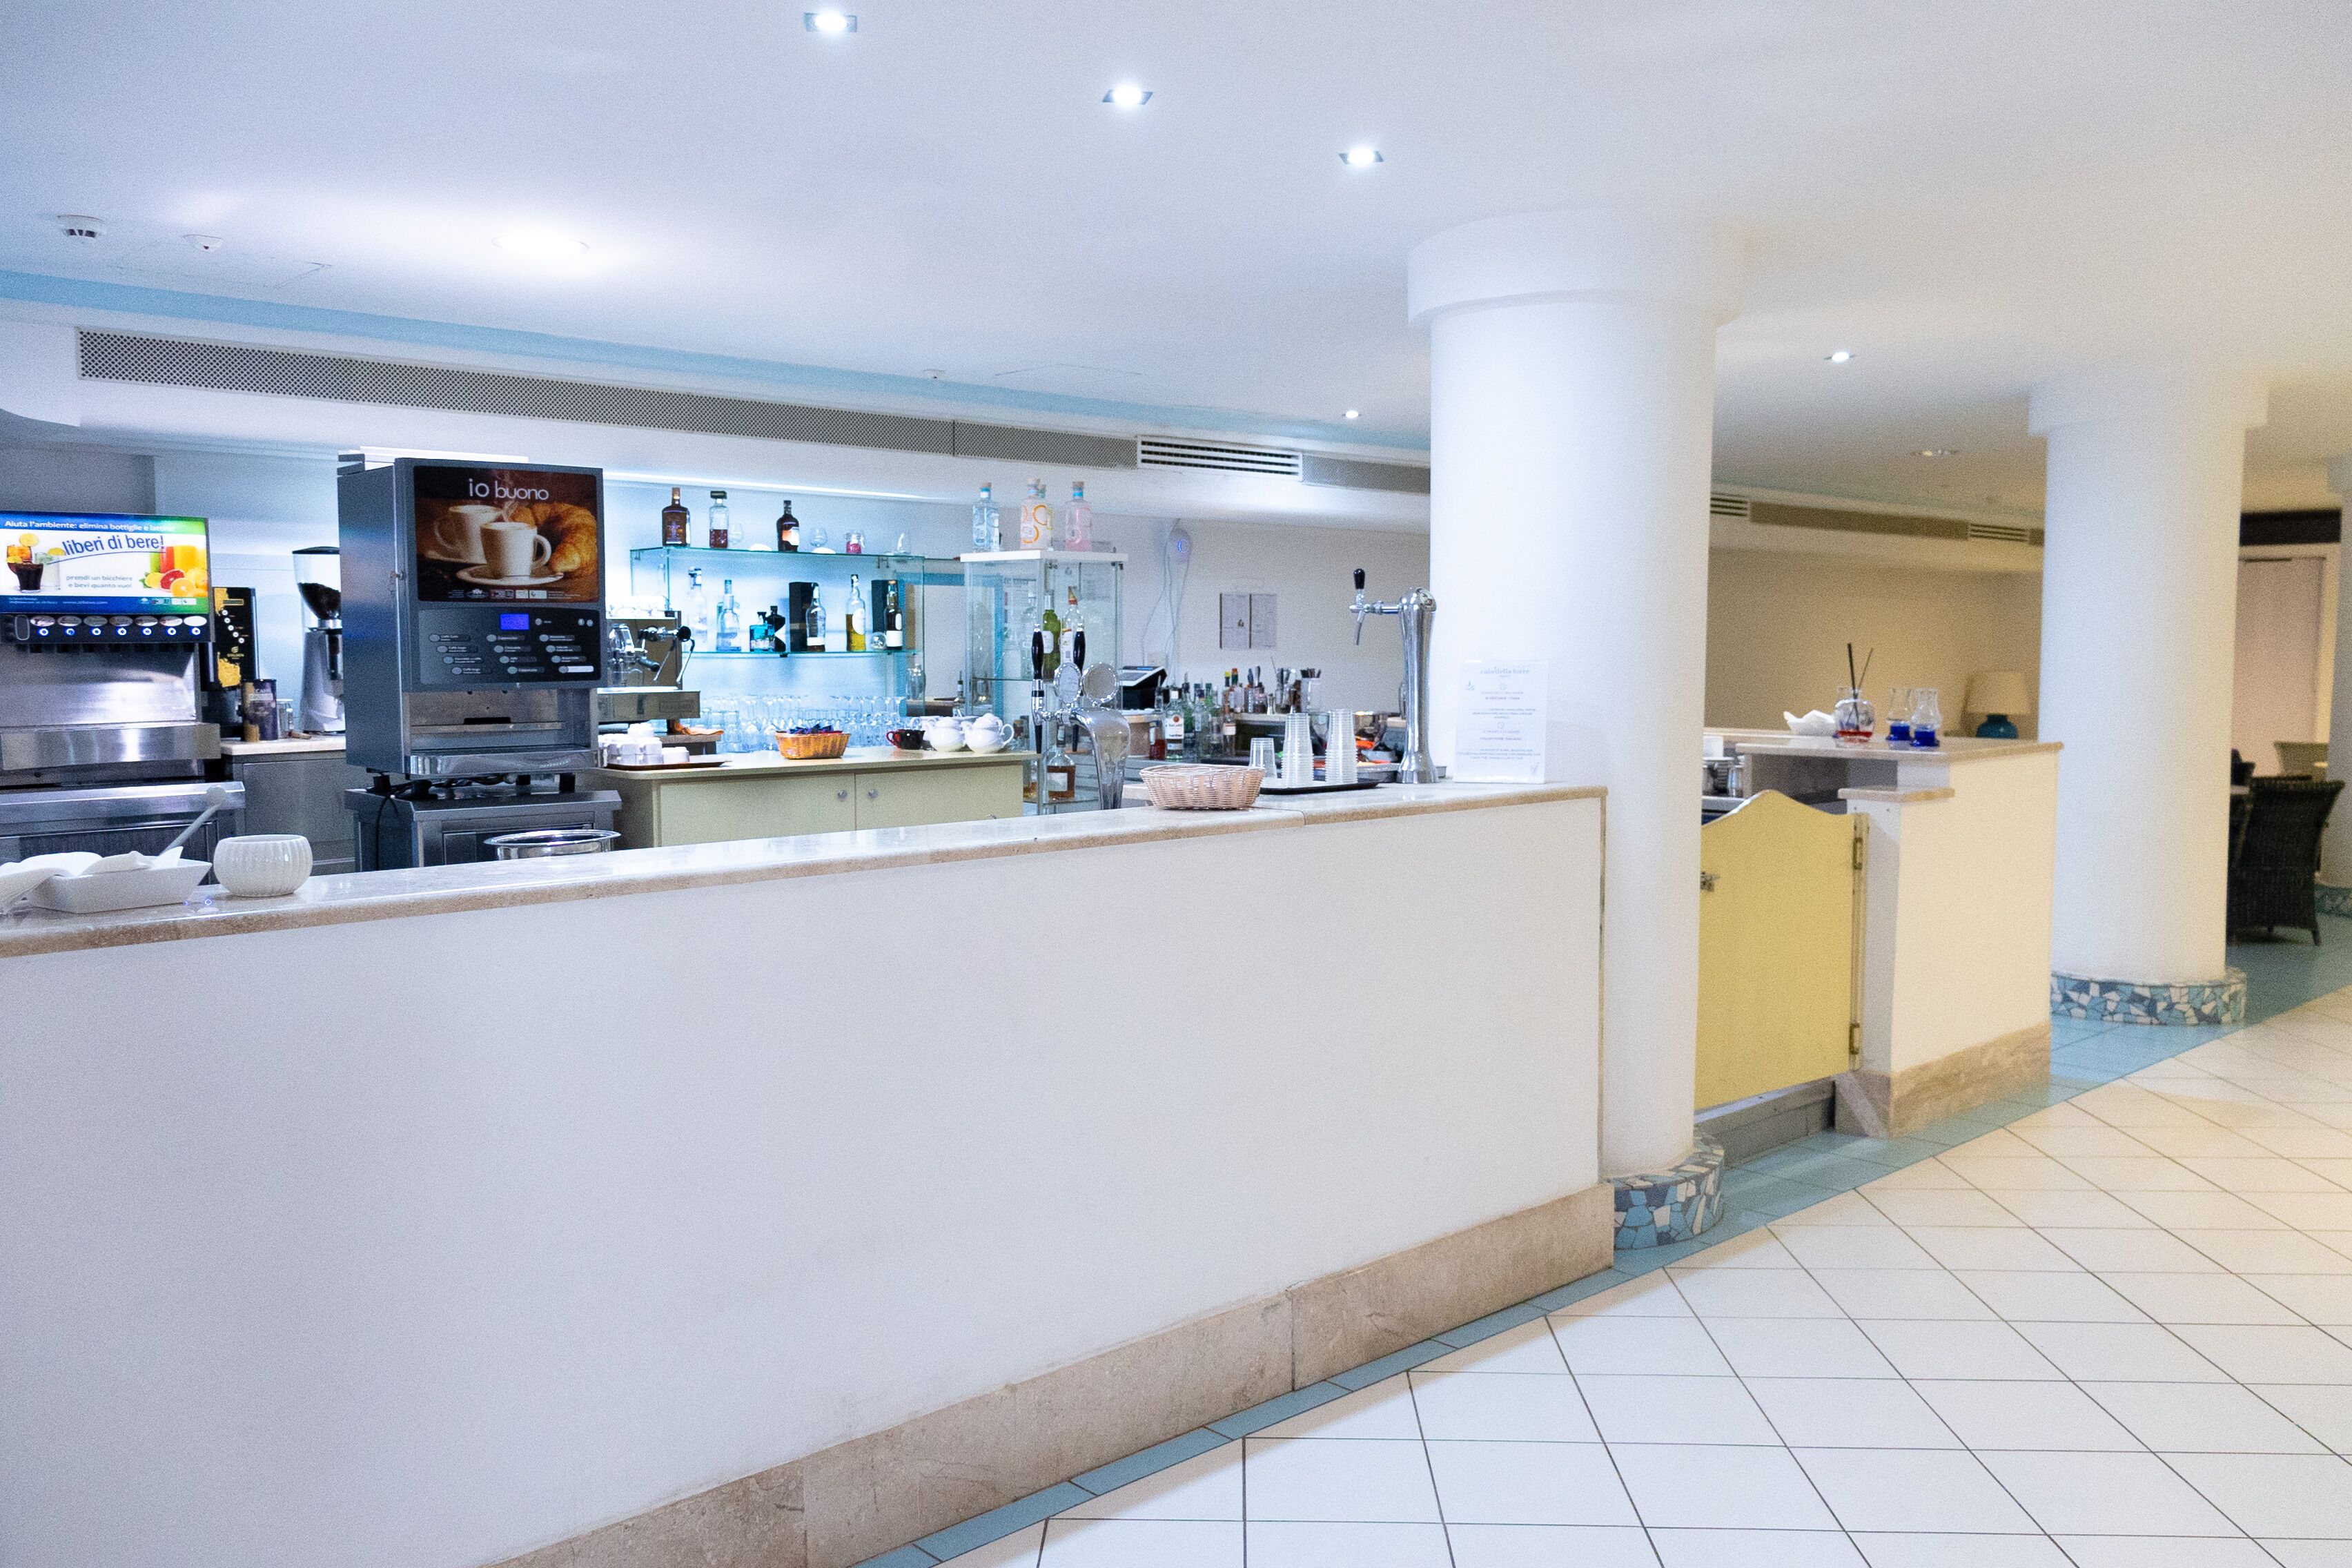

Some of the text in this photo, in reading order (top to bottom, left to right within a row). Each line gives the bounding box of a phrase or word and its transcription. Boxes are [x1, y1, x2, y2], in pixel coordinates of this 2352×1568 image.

[469, 478, 549, 500] io buono
[79, 522, 108, 530] elimina
[110, 523, 141, 532] bottiglie
[62, 535, 164, 556] liberi di bere!
